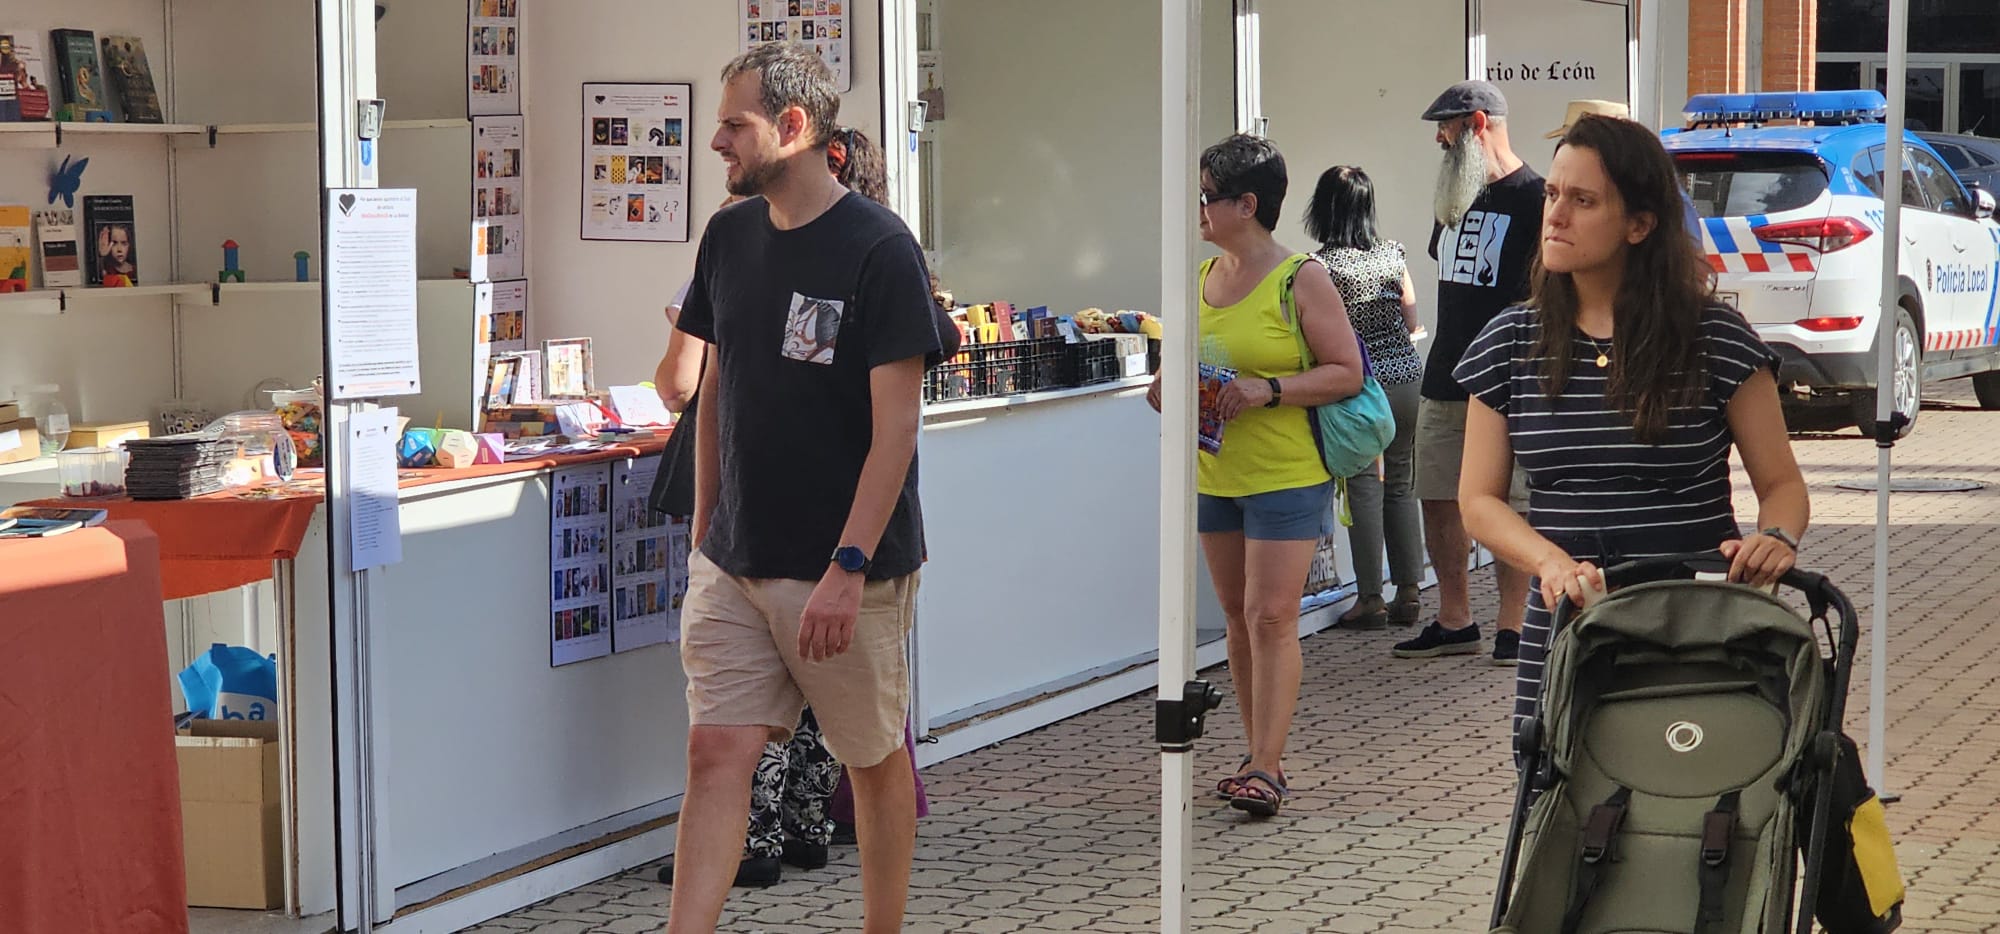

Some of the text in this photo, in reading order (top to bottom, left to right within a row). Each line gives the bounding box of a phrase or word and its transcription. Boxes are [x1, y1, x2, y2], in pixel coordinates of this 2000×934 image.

[1520, 63, 1540, 81] de
[1546, 60, 1596, 81] León
[1936, 264, 1989, 294] Policía Local
